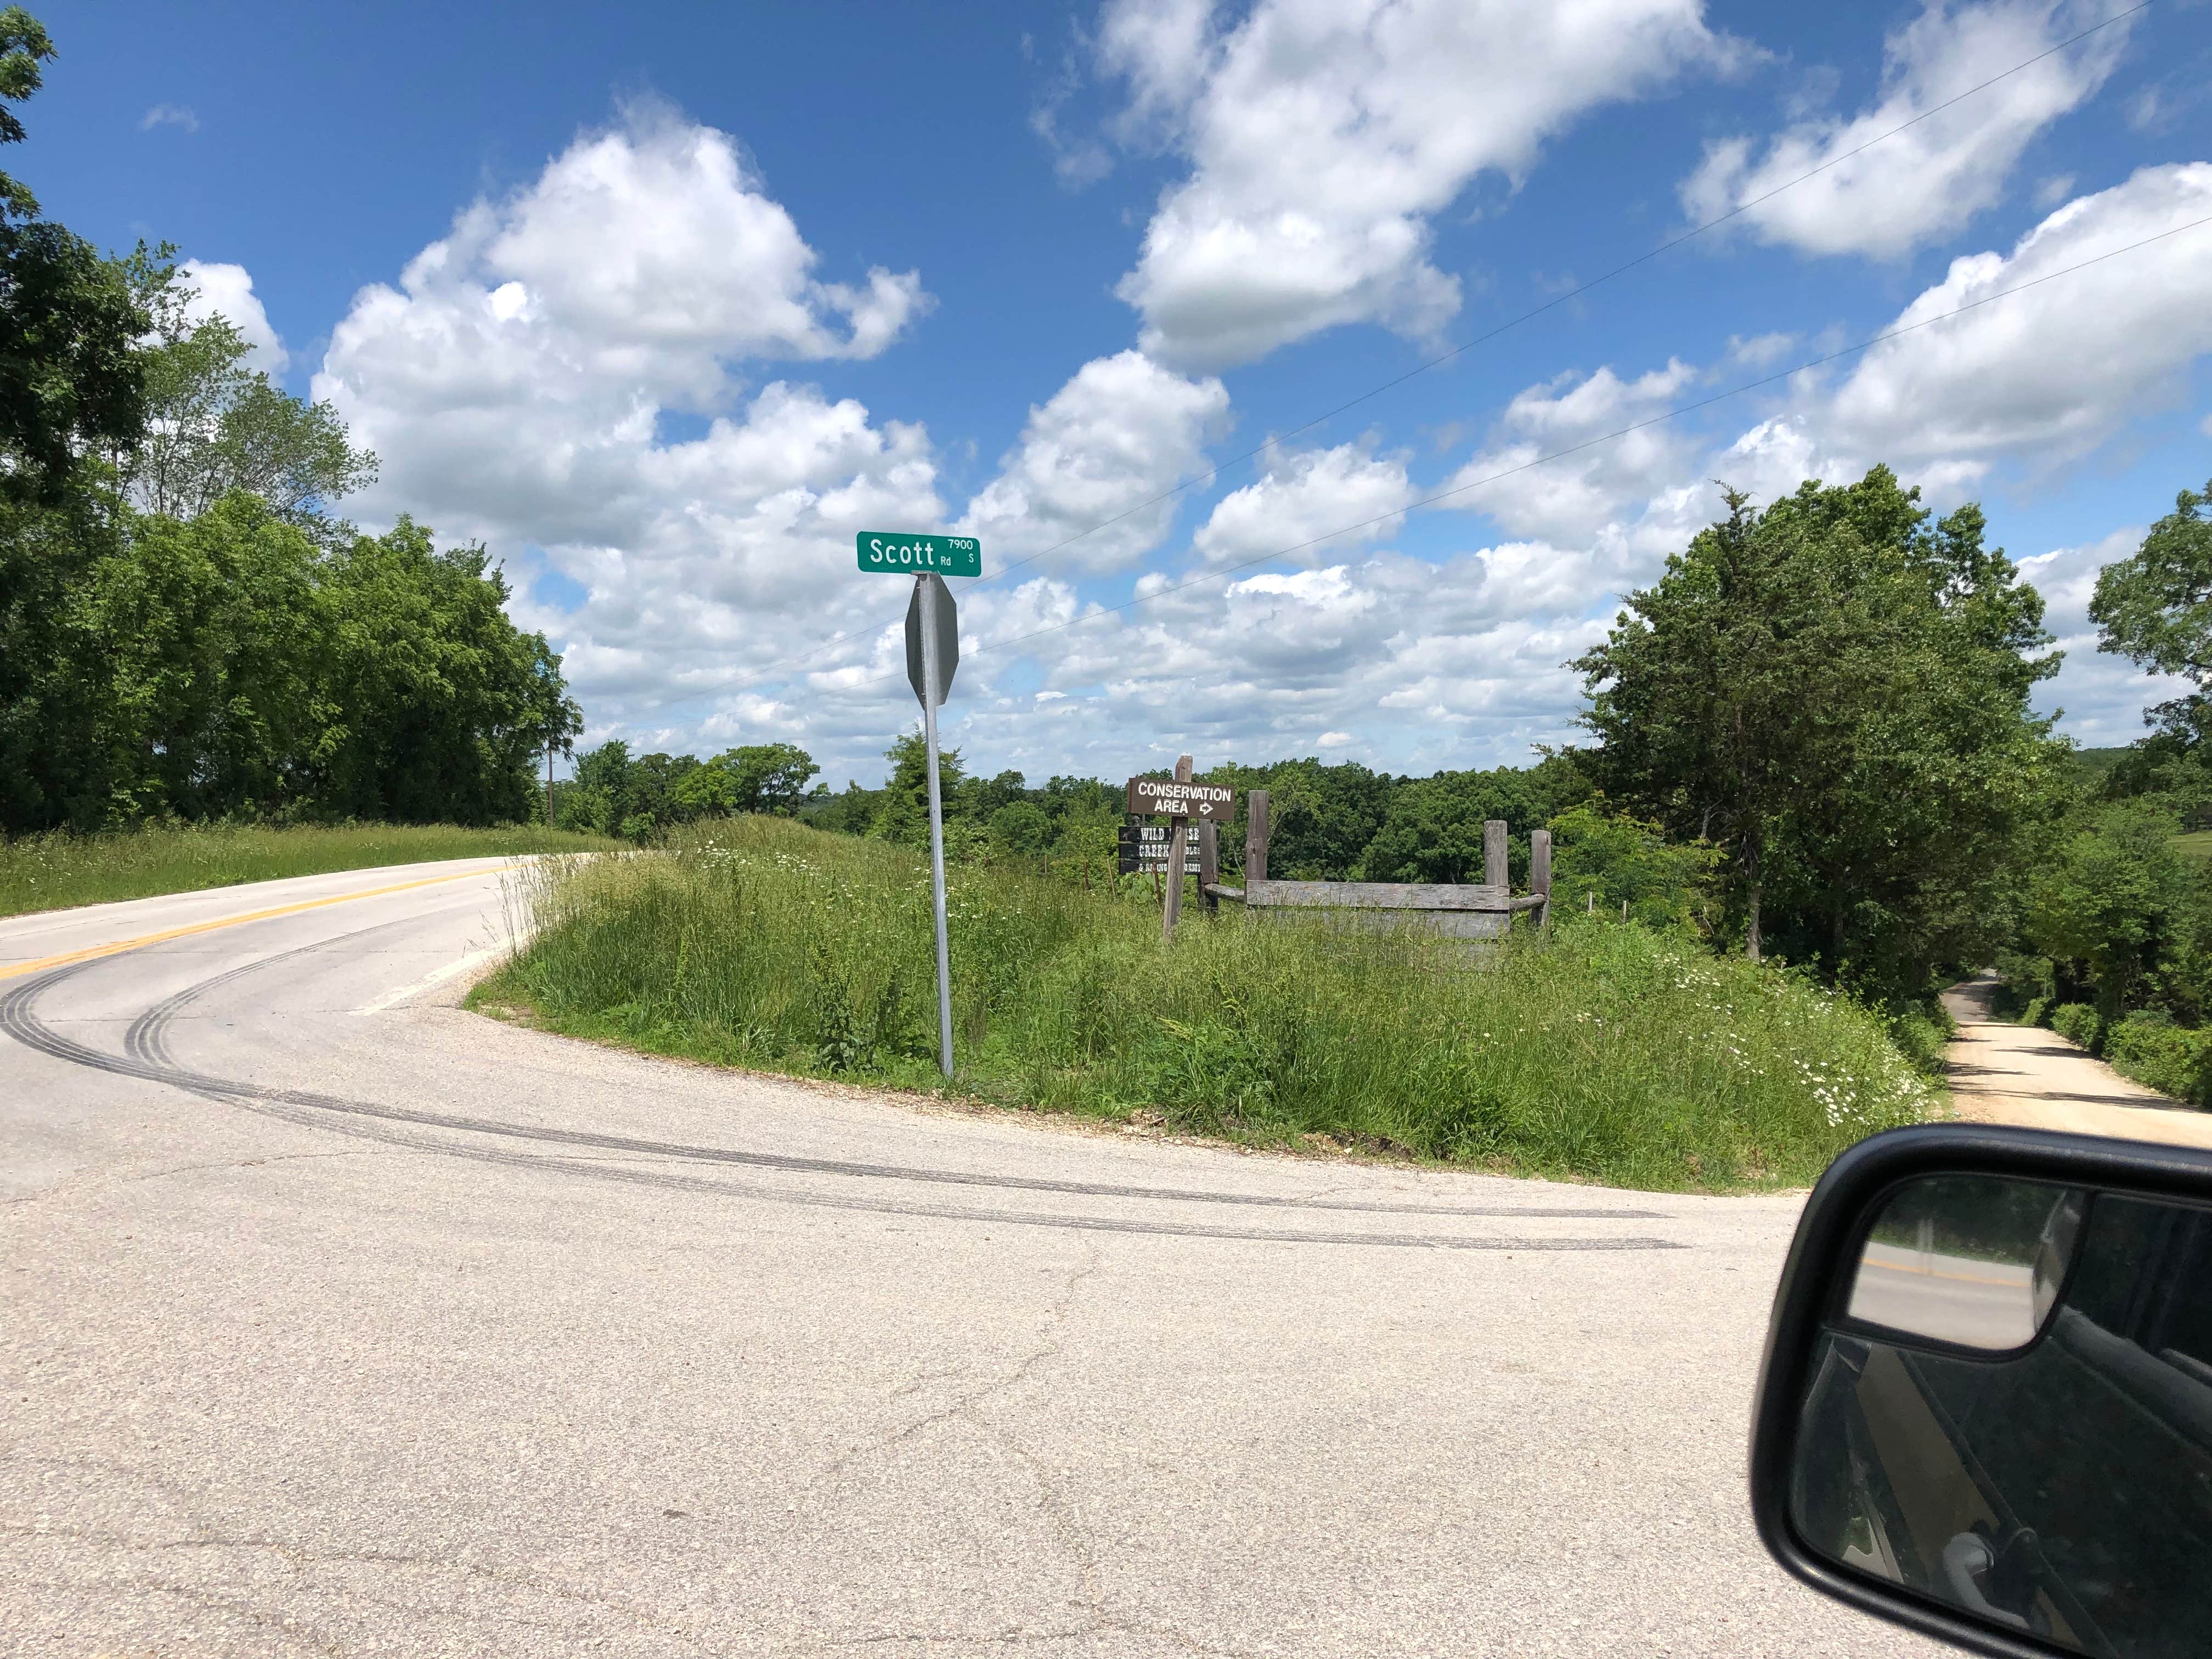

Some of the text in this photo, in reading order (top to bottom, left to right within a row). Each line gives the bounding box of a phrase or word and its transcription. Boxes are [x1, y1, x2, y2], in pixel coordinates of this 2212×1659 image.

[947, 539, 973, 550] 7900
[870, 539, 951, 566] Scott Rd
[968, 553, 974, 563] S
[1138, 782, 1231, 802] CONSERVATION
[1154, 798, 1188, 814] AREA
[1141, 827, 1164, 840] WILD
[1139, 844, 1170, 857] CREEK
